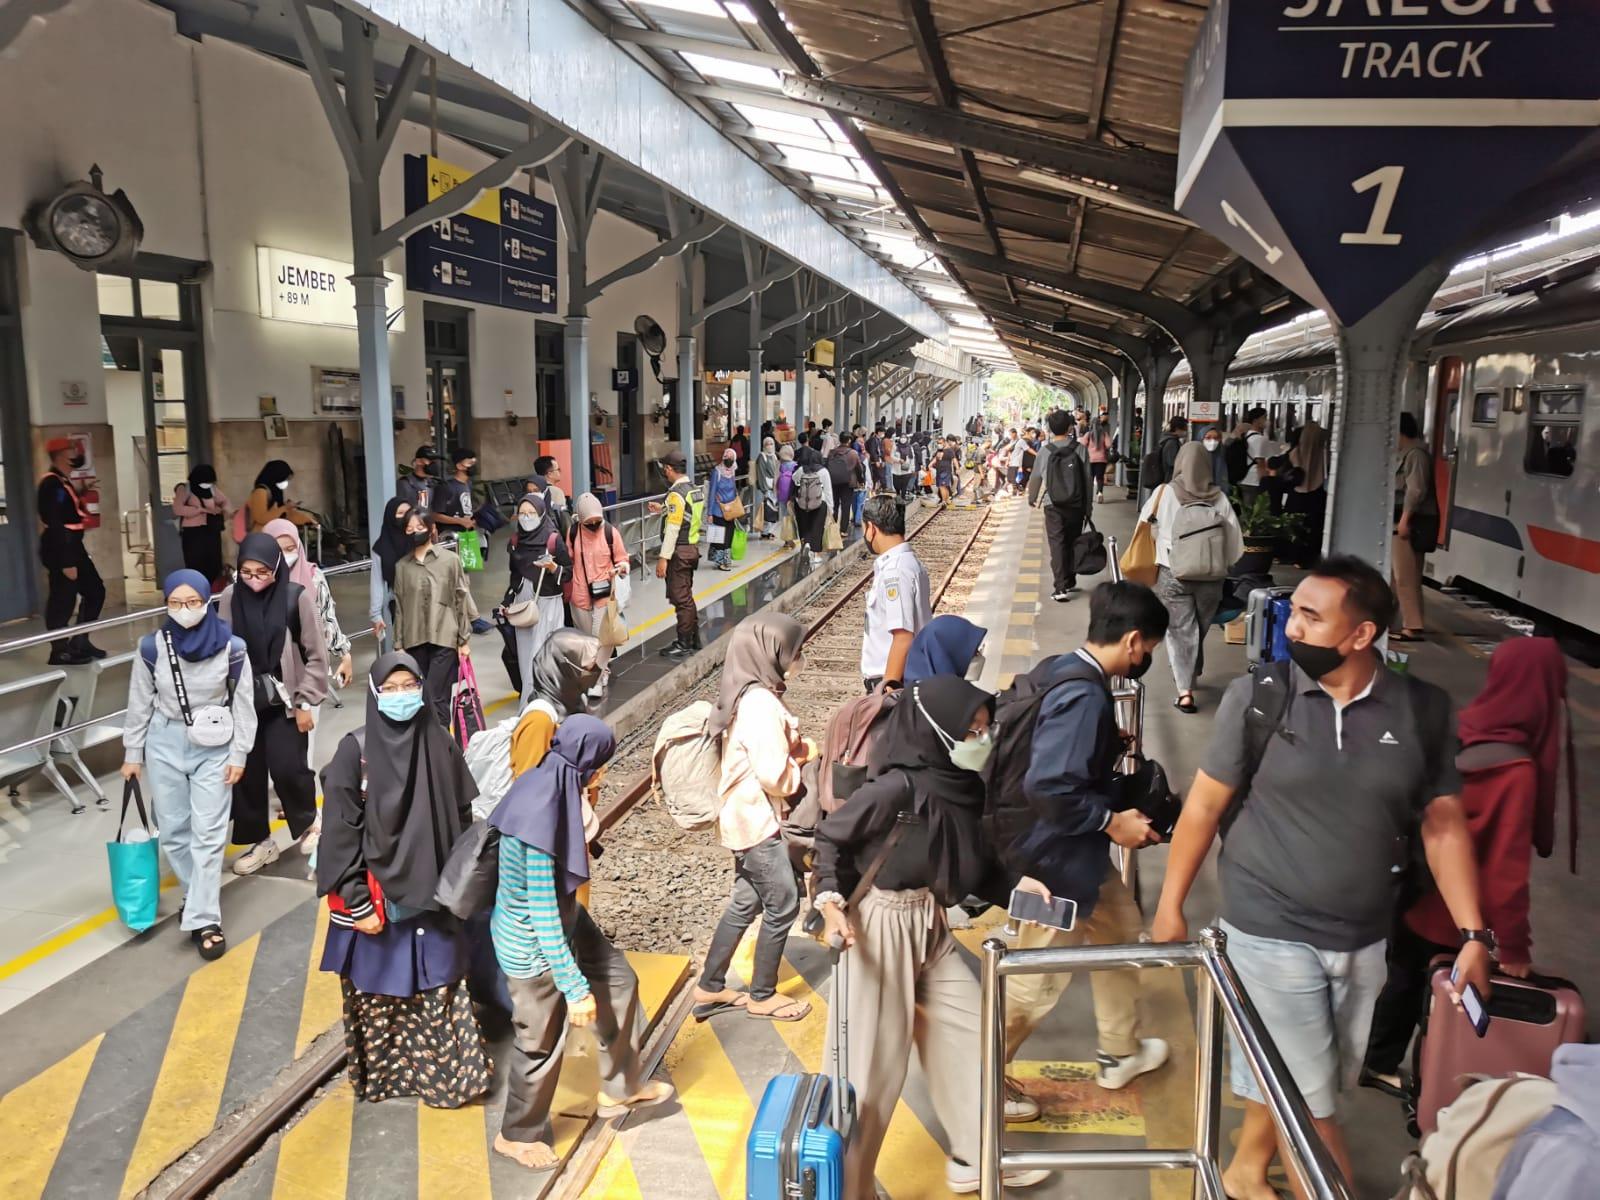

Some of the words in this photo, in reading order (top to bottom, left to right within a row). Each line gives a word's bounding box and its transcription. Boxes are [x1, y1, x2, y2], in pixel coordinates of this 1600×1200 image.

[1339, 40, 1492, 79] TRACK
[1339, 165, 1405, 246] 1
[278, 264, 336, 293] JEMBER
[287, 291, 298, 304] 89
[301, 293, 310, 306] M
